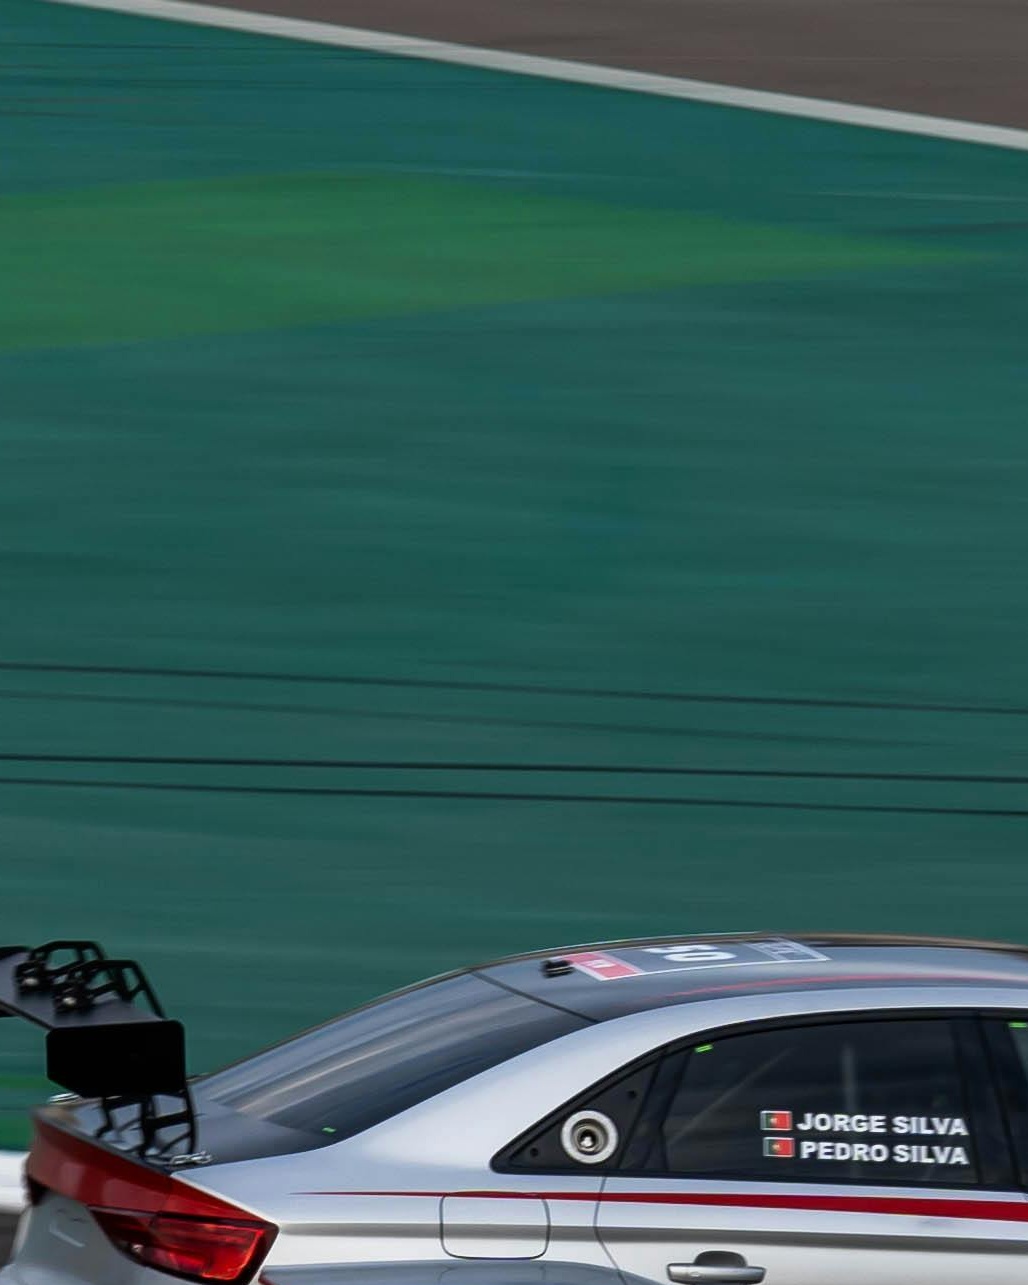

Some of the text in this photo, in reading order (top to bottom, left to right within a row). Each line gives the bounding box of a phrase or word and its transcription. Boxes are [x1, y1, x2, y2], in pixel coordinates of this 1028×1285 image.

[796, 1113, 969, 1136] JORGE SILVA
[801, 1141, 970, 1165] PEDRO SILVA
